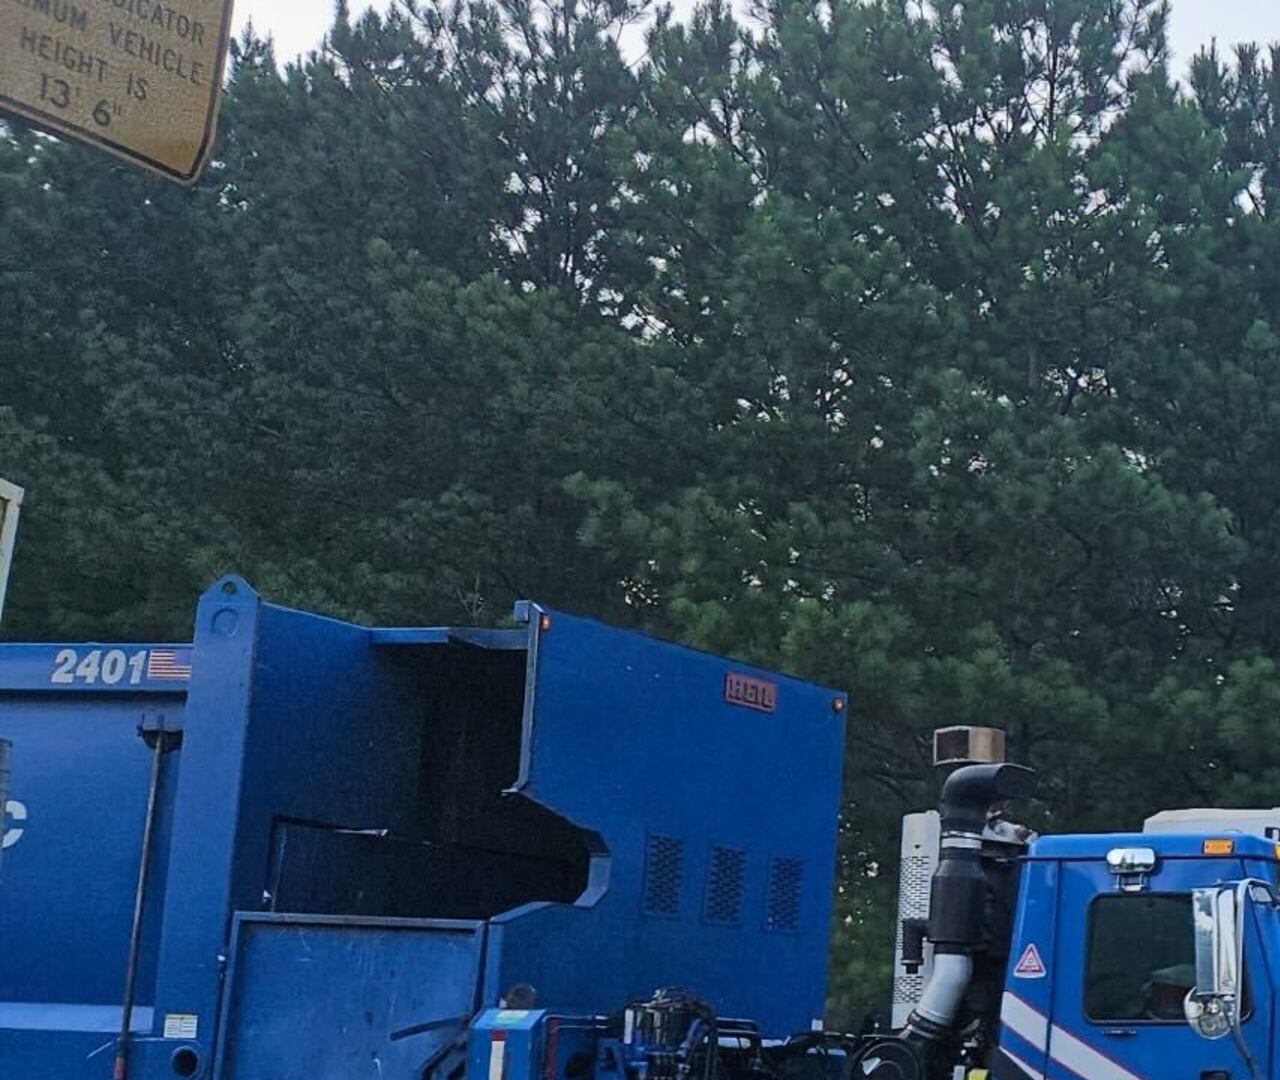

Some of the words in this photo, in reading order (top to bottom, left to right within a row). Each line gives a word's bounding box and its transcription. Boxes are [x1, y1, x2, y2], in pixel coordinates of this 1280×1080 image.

[20, 26, 109, 82] HEIGHT
[127, 73, 148, 101] IS
[109, 22, 204, 86] VEHICLE
[52, 649, 148, 684] 2401
